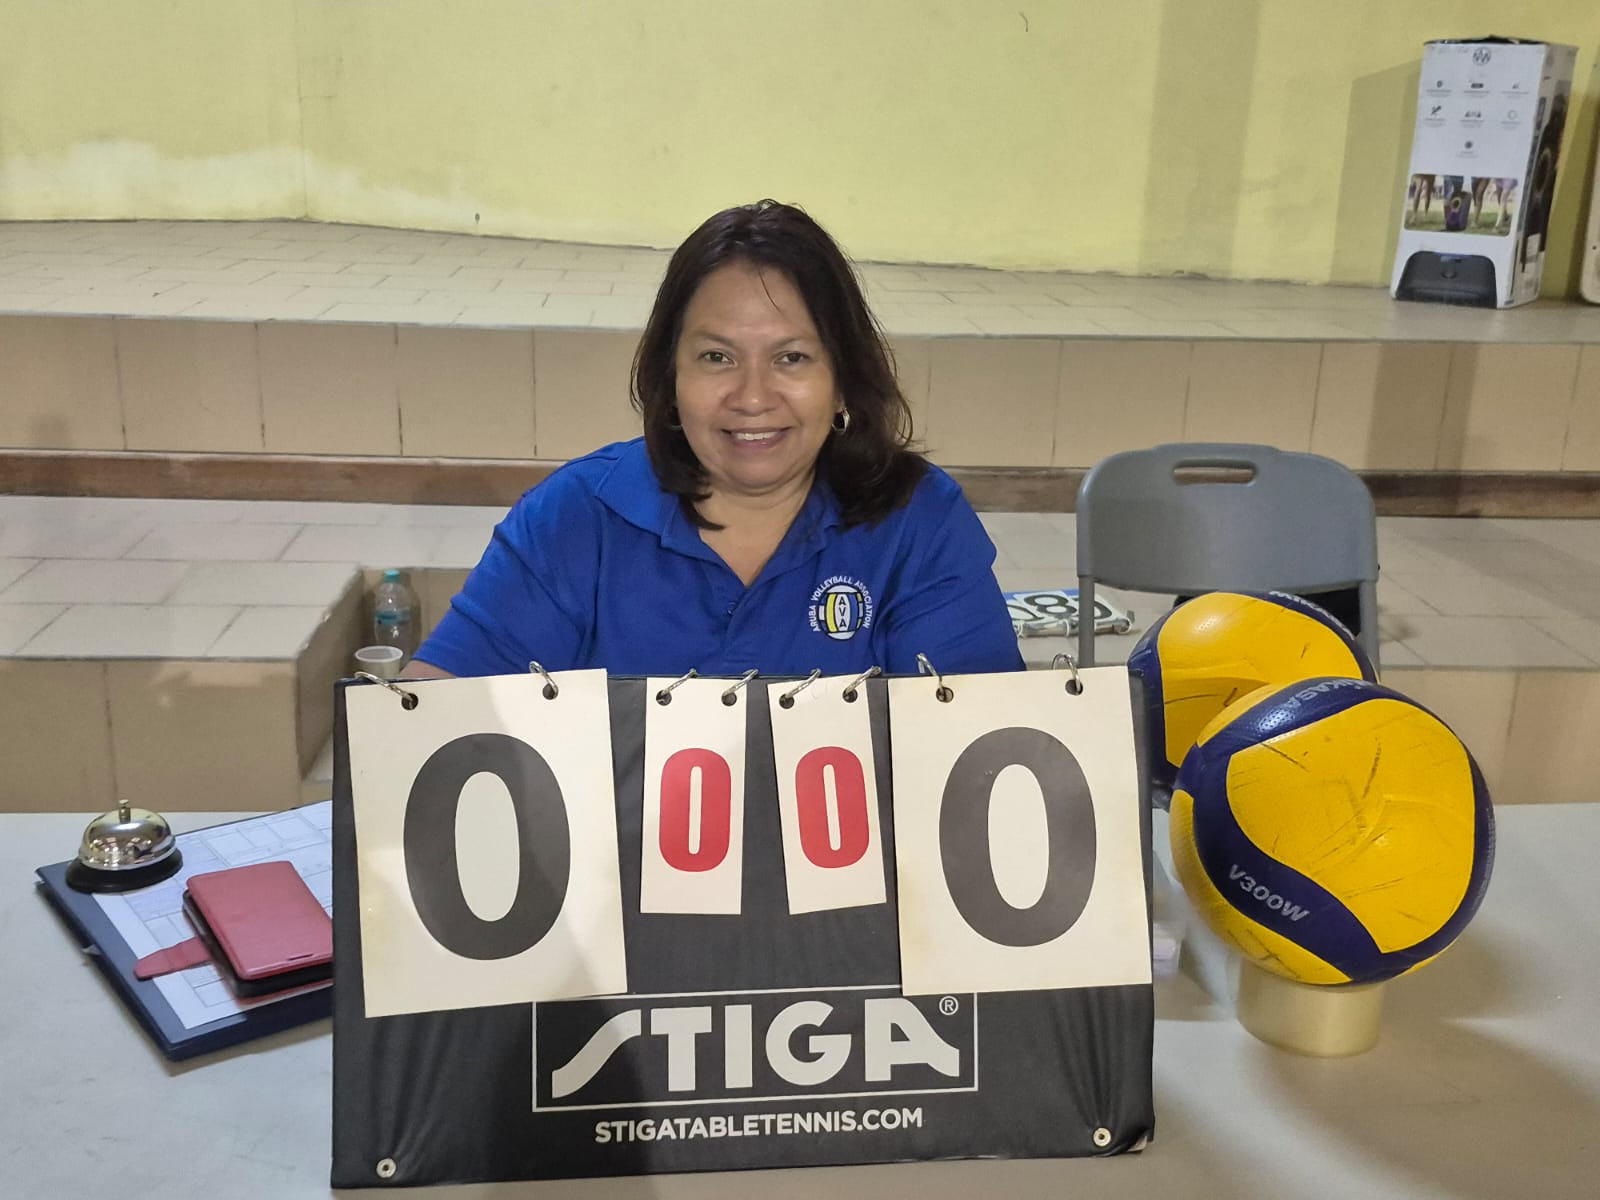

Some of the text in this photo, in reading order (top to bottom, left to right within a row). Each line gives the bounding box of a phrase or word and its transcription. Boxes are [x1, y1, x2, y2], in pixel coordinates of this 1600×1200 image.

[808, 575, 873, 632] ARUBA VOLLEYBALL ASSOCIATION
[838, 596, 847, 628] AVA
[402, 732, 571, 960] 0
[658, 747, 732, 873] 0
[794, 745, 870, 869] 0
[938, 726, 1097, 948] 0
[1229, 863, 1311, 922] V300W
[551, 997, 960, 1099] STIGA
[594, 1107, 923, 1143] STIGATABLETENNIS.COM
